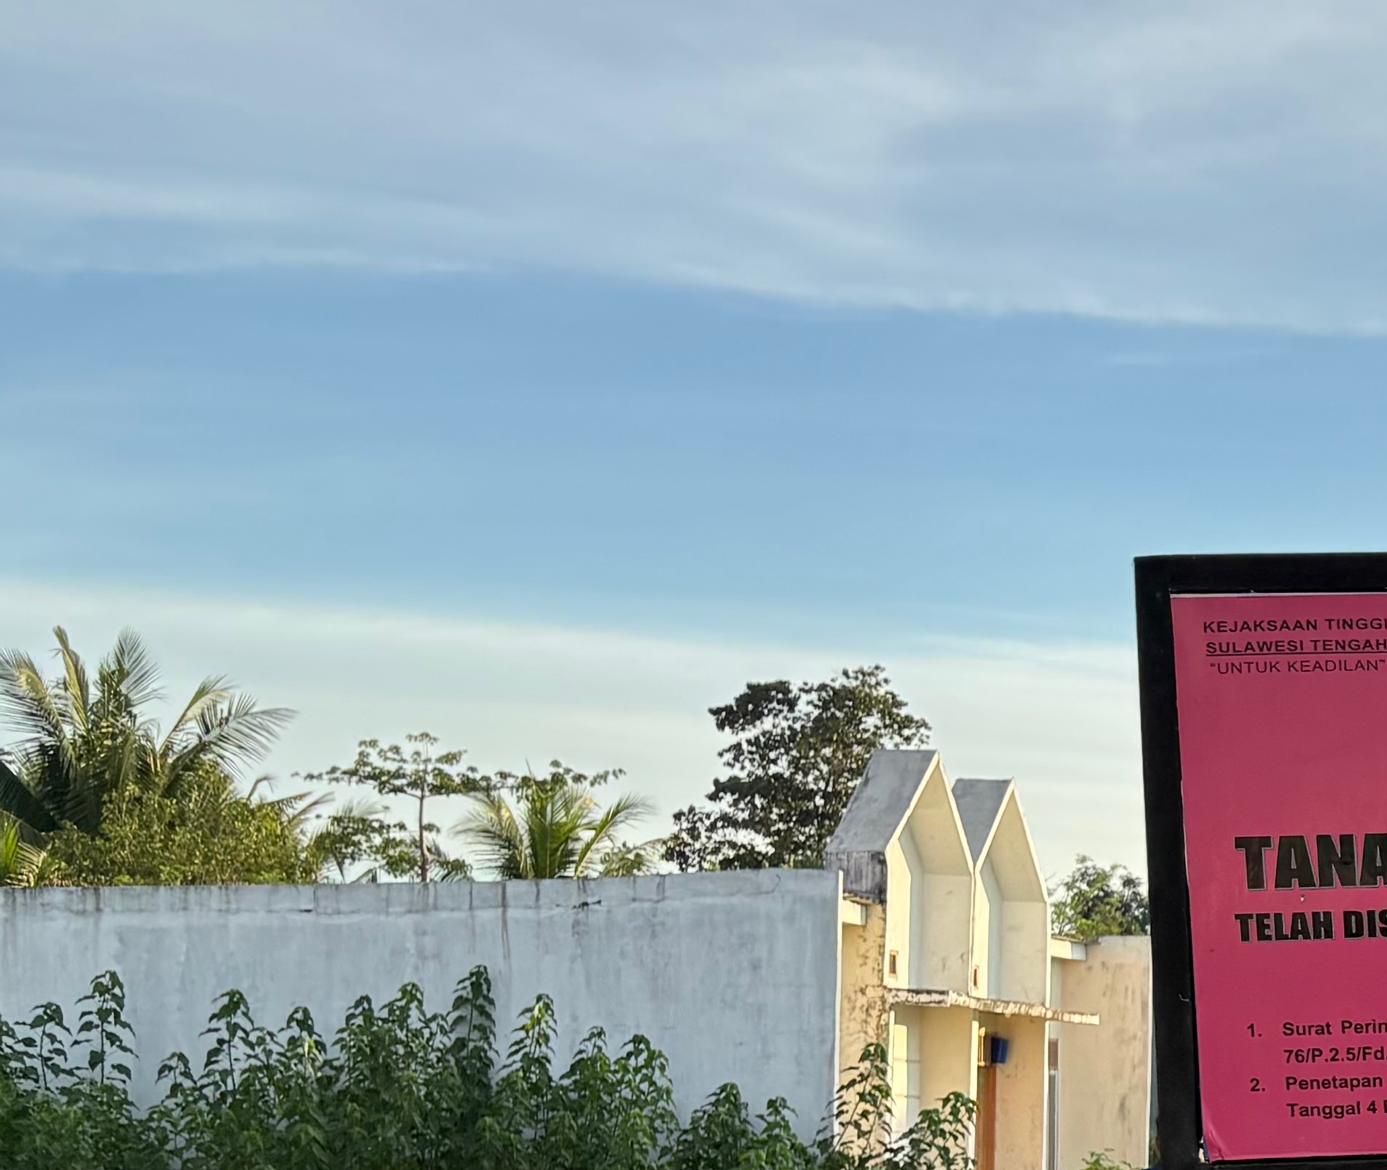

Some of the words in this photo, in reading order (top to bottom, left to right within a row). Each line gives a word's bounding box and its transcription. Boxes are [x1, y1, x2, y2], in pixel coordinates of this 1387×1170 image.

[1203, 619, 1318, 634] KEJAKSAAN
[1325, 618, 1387, 631] TINGGI
[1205, 640, 1303, 654] SULAWESI
[1311, 638, 1387, 652] TENGAH
[1210, 661, 1281, 675] "UNTUK
[1286, 659, 1386, 673] KEADILAN"
[1234, 911, 1334, 943] TELAH
[1247, 1023, 1263, 1038] 1.
[1282, 1021, 1332, 1037] Surat
[1249, 1078, 1266, 1093] 2.
[1285, 1074, 1383, 1092] Penetapan
[1286, 1101, 1361, 1120] Tanggal
[1367, 1100, 1377, 1115] 4
